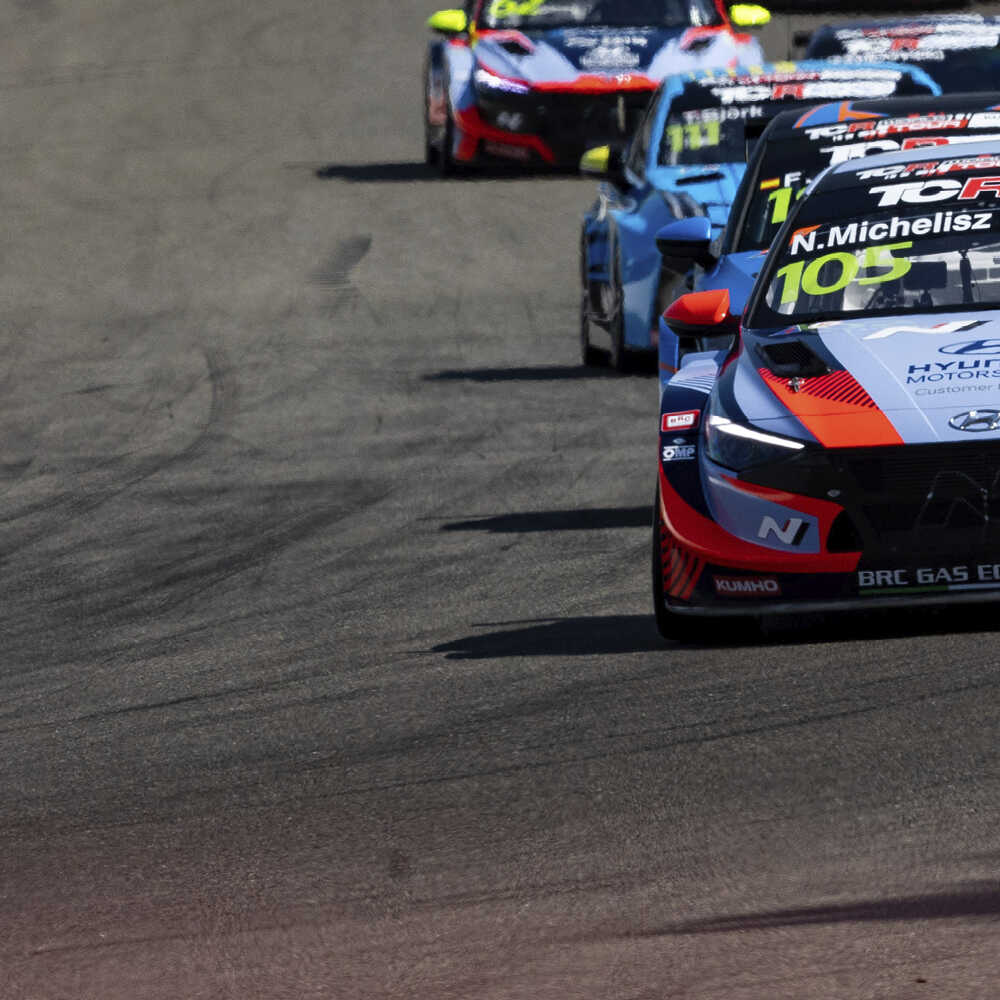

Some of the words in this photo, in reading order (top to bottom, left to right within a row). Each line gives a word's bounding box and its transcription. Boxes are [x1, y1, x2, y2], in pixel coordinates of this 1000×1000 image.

[665, 120, 720, 153] 111
[768, 187, 806, 224] 1
[776, 241, 913, 305] 105
[914, 382, 993, 396] Customer
[663, 446, 696, 460] OMP
[715, 578, 778, 592] KUMHO
[858, 569, 909, 586] BRC
[916, 565, 969, 584] GAS
